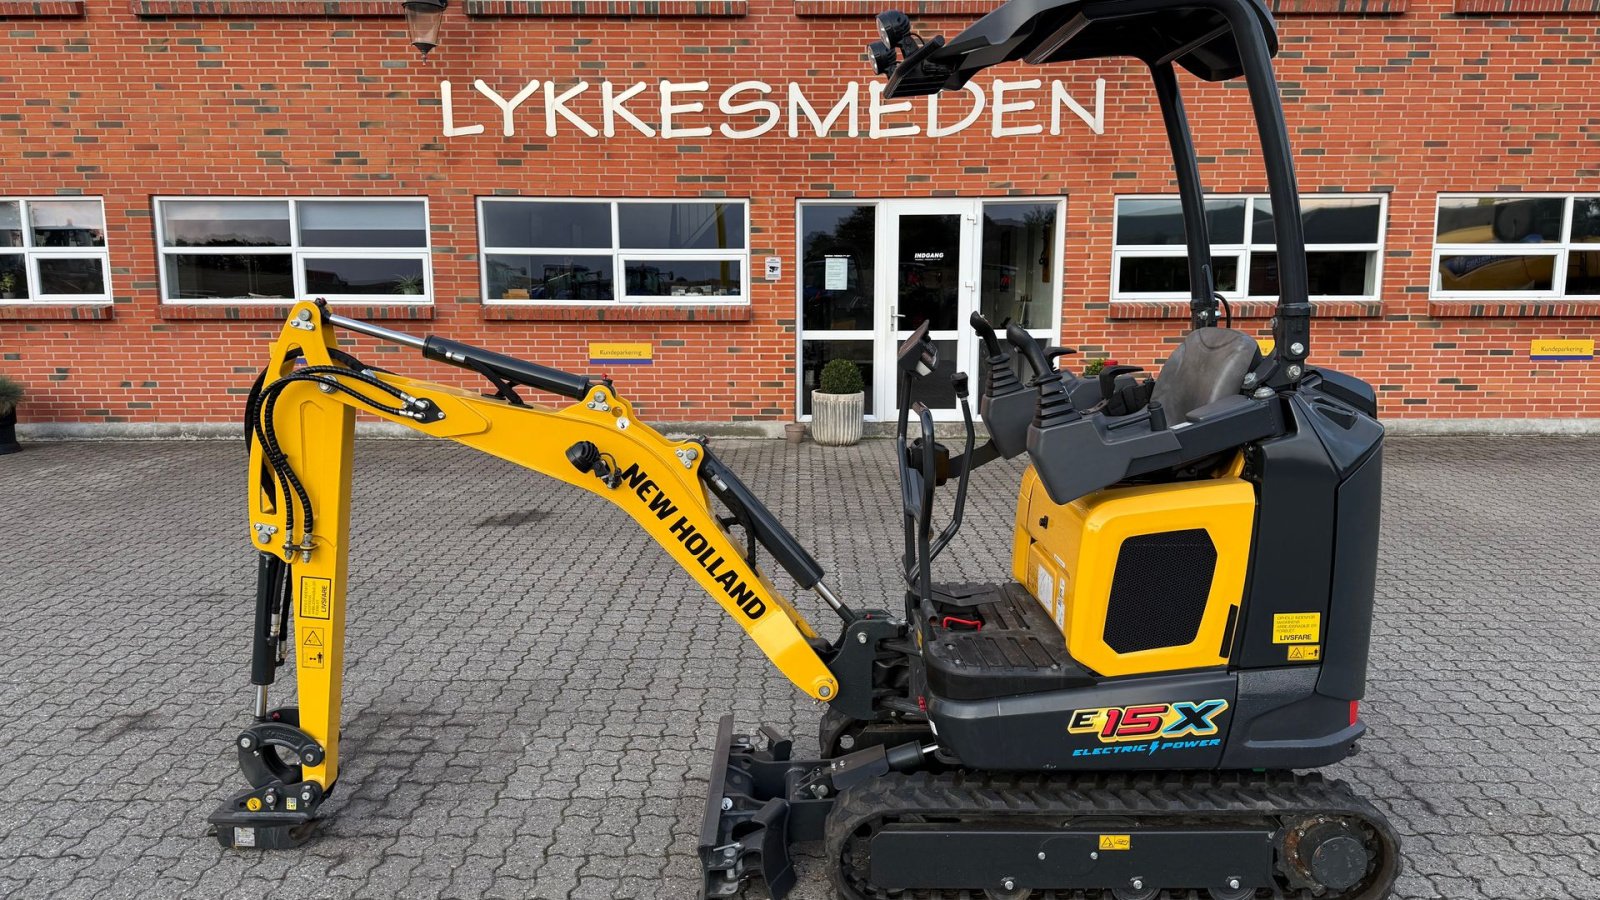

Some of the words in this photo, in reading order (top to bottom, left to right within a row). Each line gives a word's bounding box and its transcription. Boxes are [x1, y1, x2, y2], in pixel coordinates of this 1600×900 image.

[440, 78, 1106, 139] LYKKESMEDEN
[599, 349, 642, 357] Kundeparkering
[621, 463, 678, 521] NEW
[669, 515, 767, 620] HOLLAND
[1072, 744, 1148, 757] ELECTRIC
[1161, 738, 1221, 750] POWER
